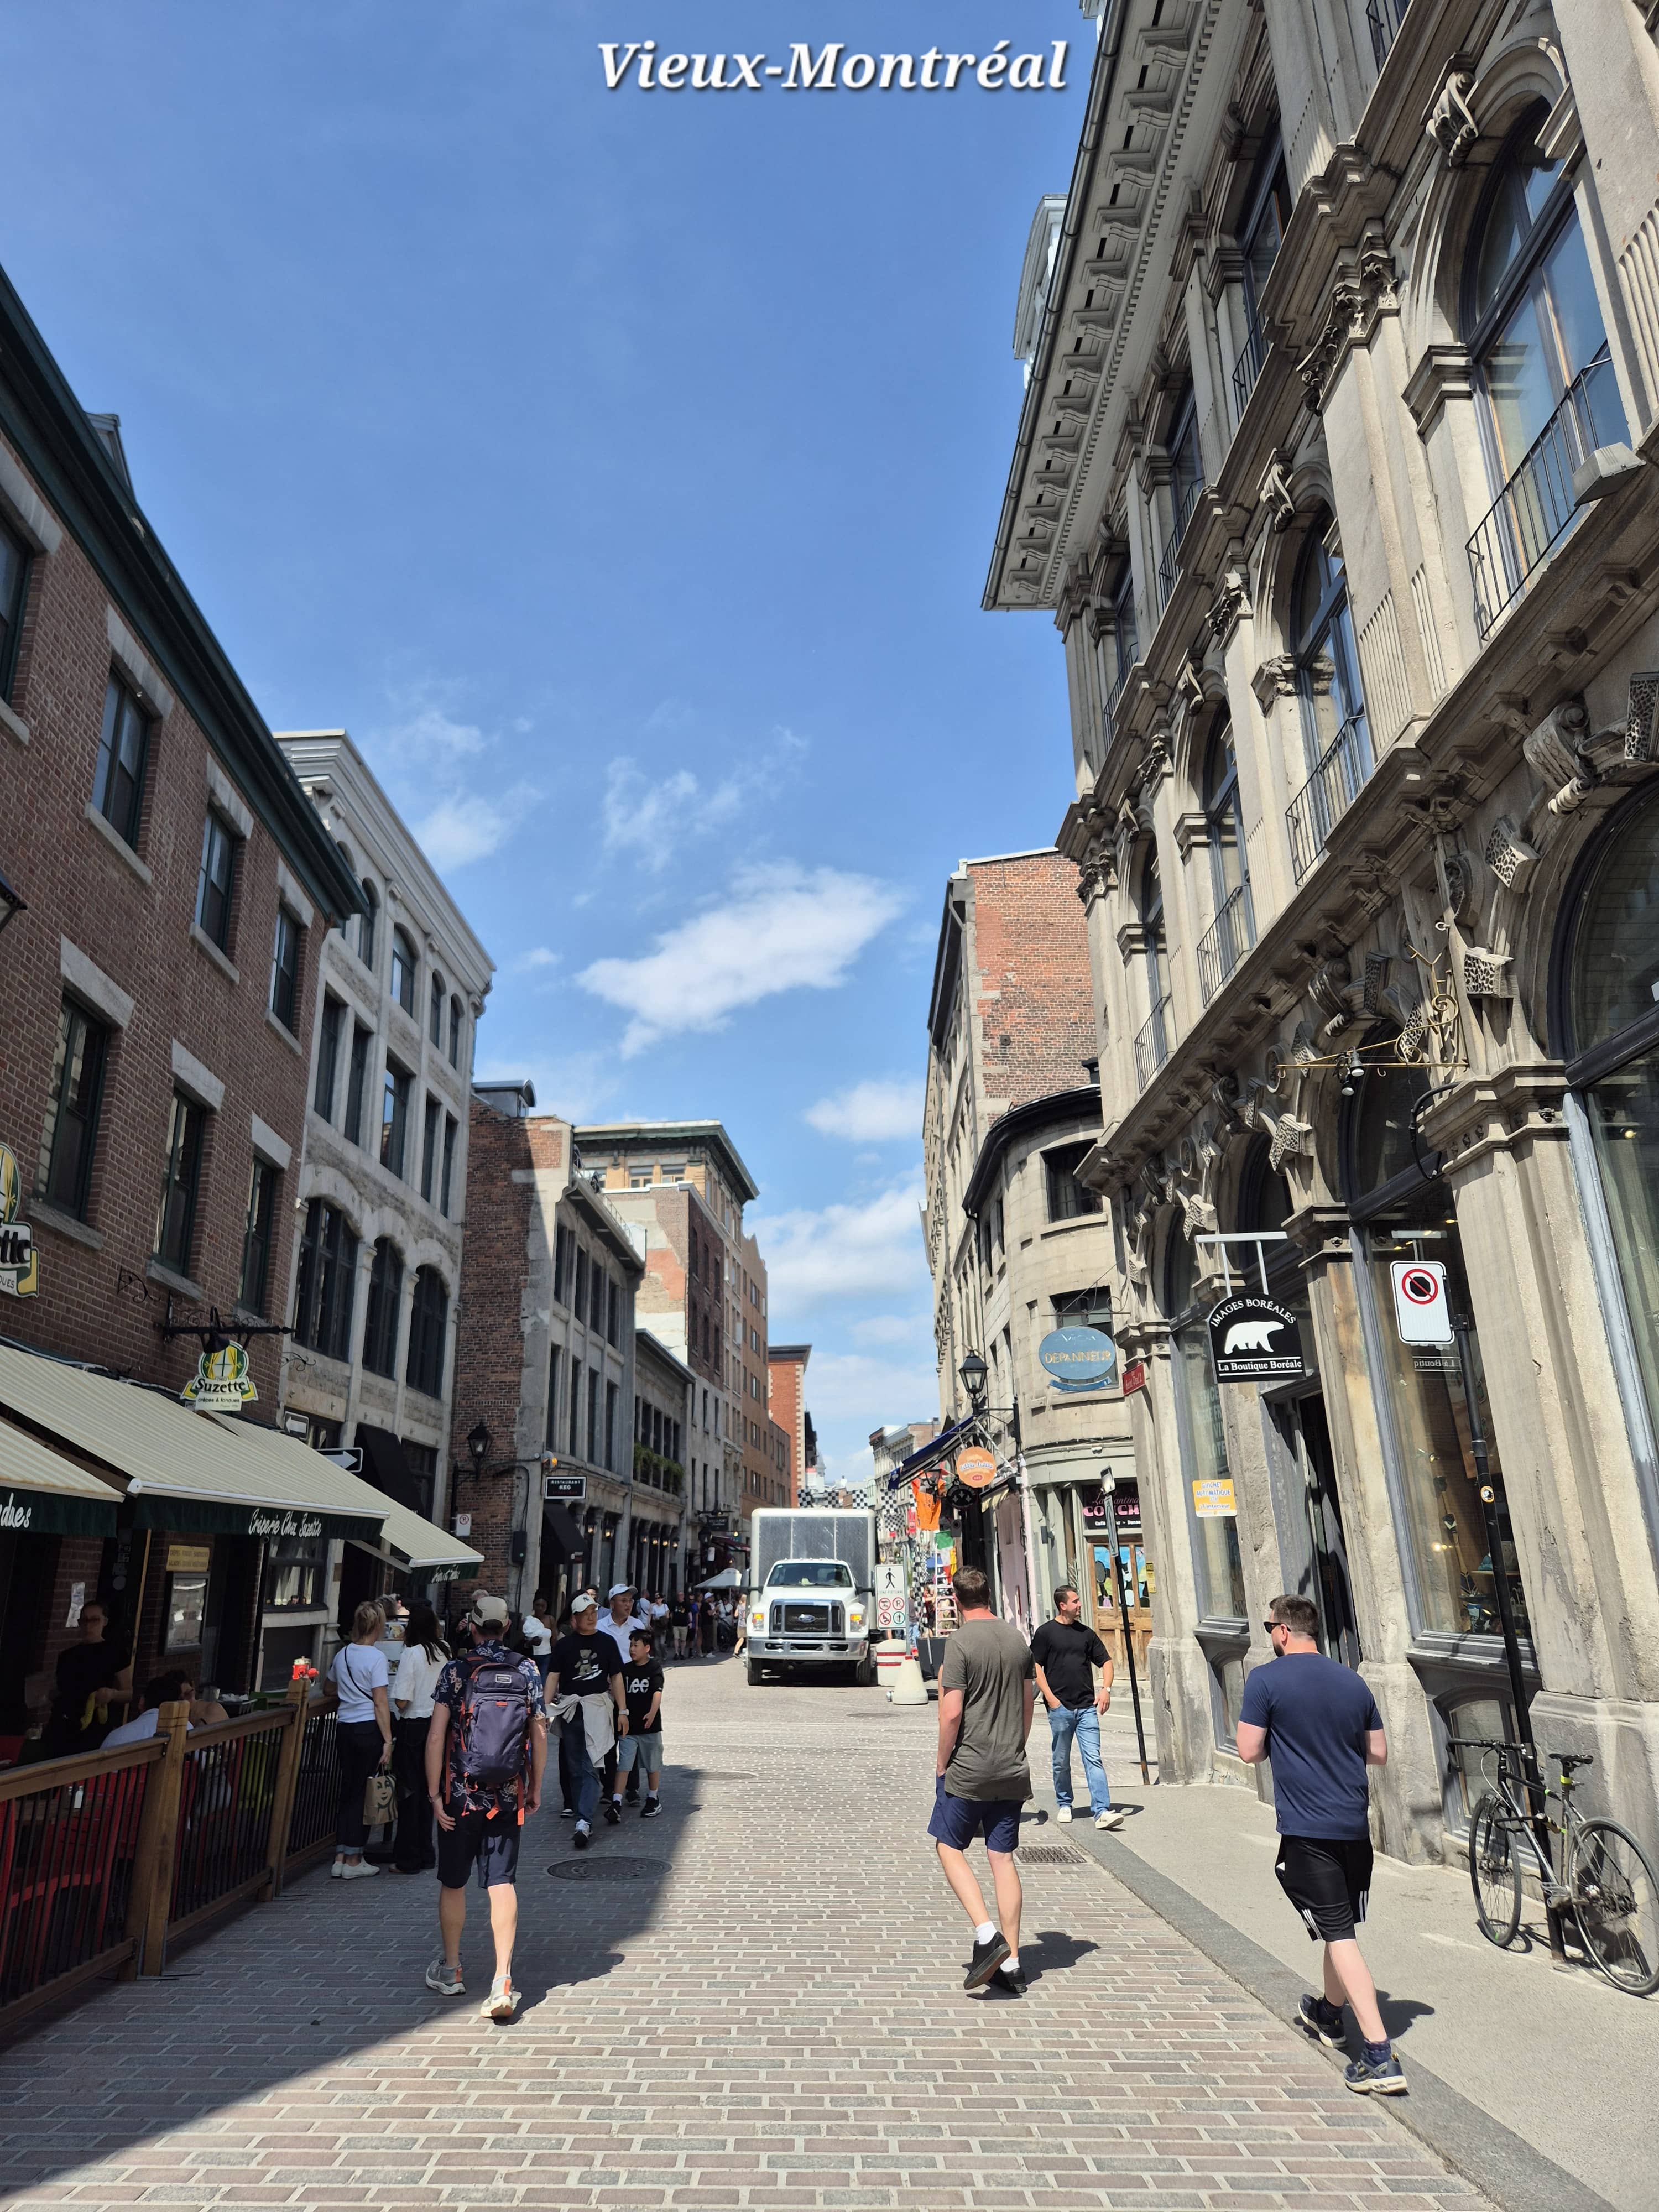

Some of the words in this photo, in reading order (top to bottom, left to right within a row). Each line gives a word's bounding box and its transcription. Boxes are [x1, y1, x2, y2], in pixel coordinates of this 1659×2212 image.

[0, 1230, 31, 1264] tte
[1211, 1300, 1244, 1328] IMAGES
[1245, 1299, 1296, 1324] BORÉALES
[1218, 1363, 1229, 1371] La
[1230, 1361, 1268, 1371] Boutique
[1270, 1359, 1302, 1369] Boréale
[195, 1378, 246, 1392] Suzette
[1083, 1504, 1140, 1517] COCH
[625, 1676, 650, 1693] Lee
